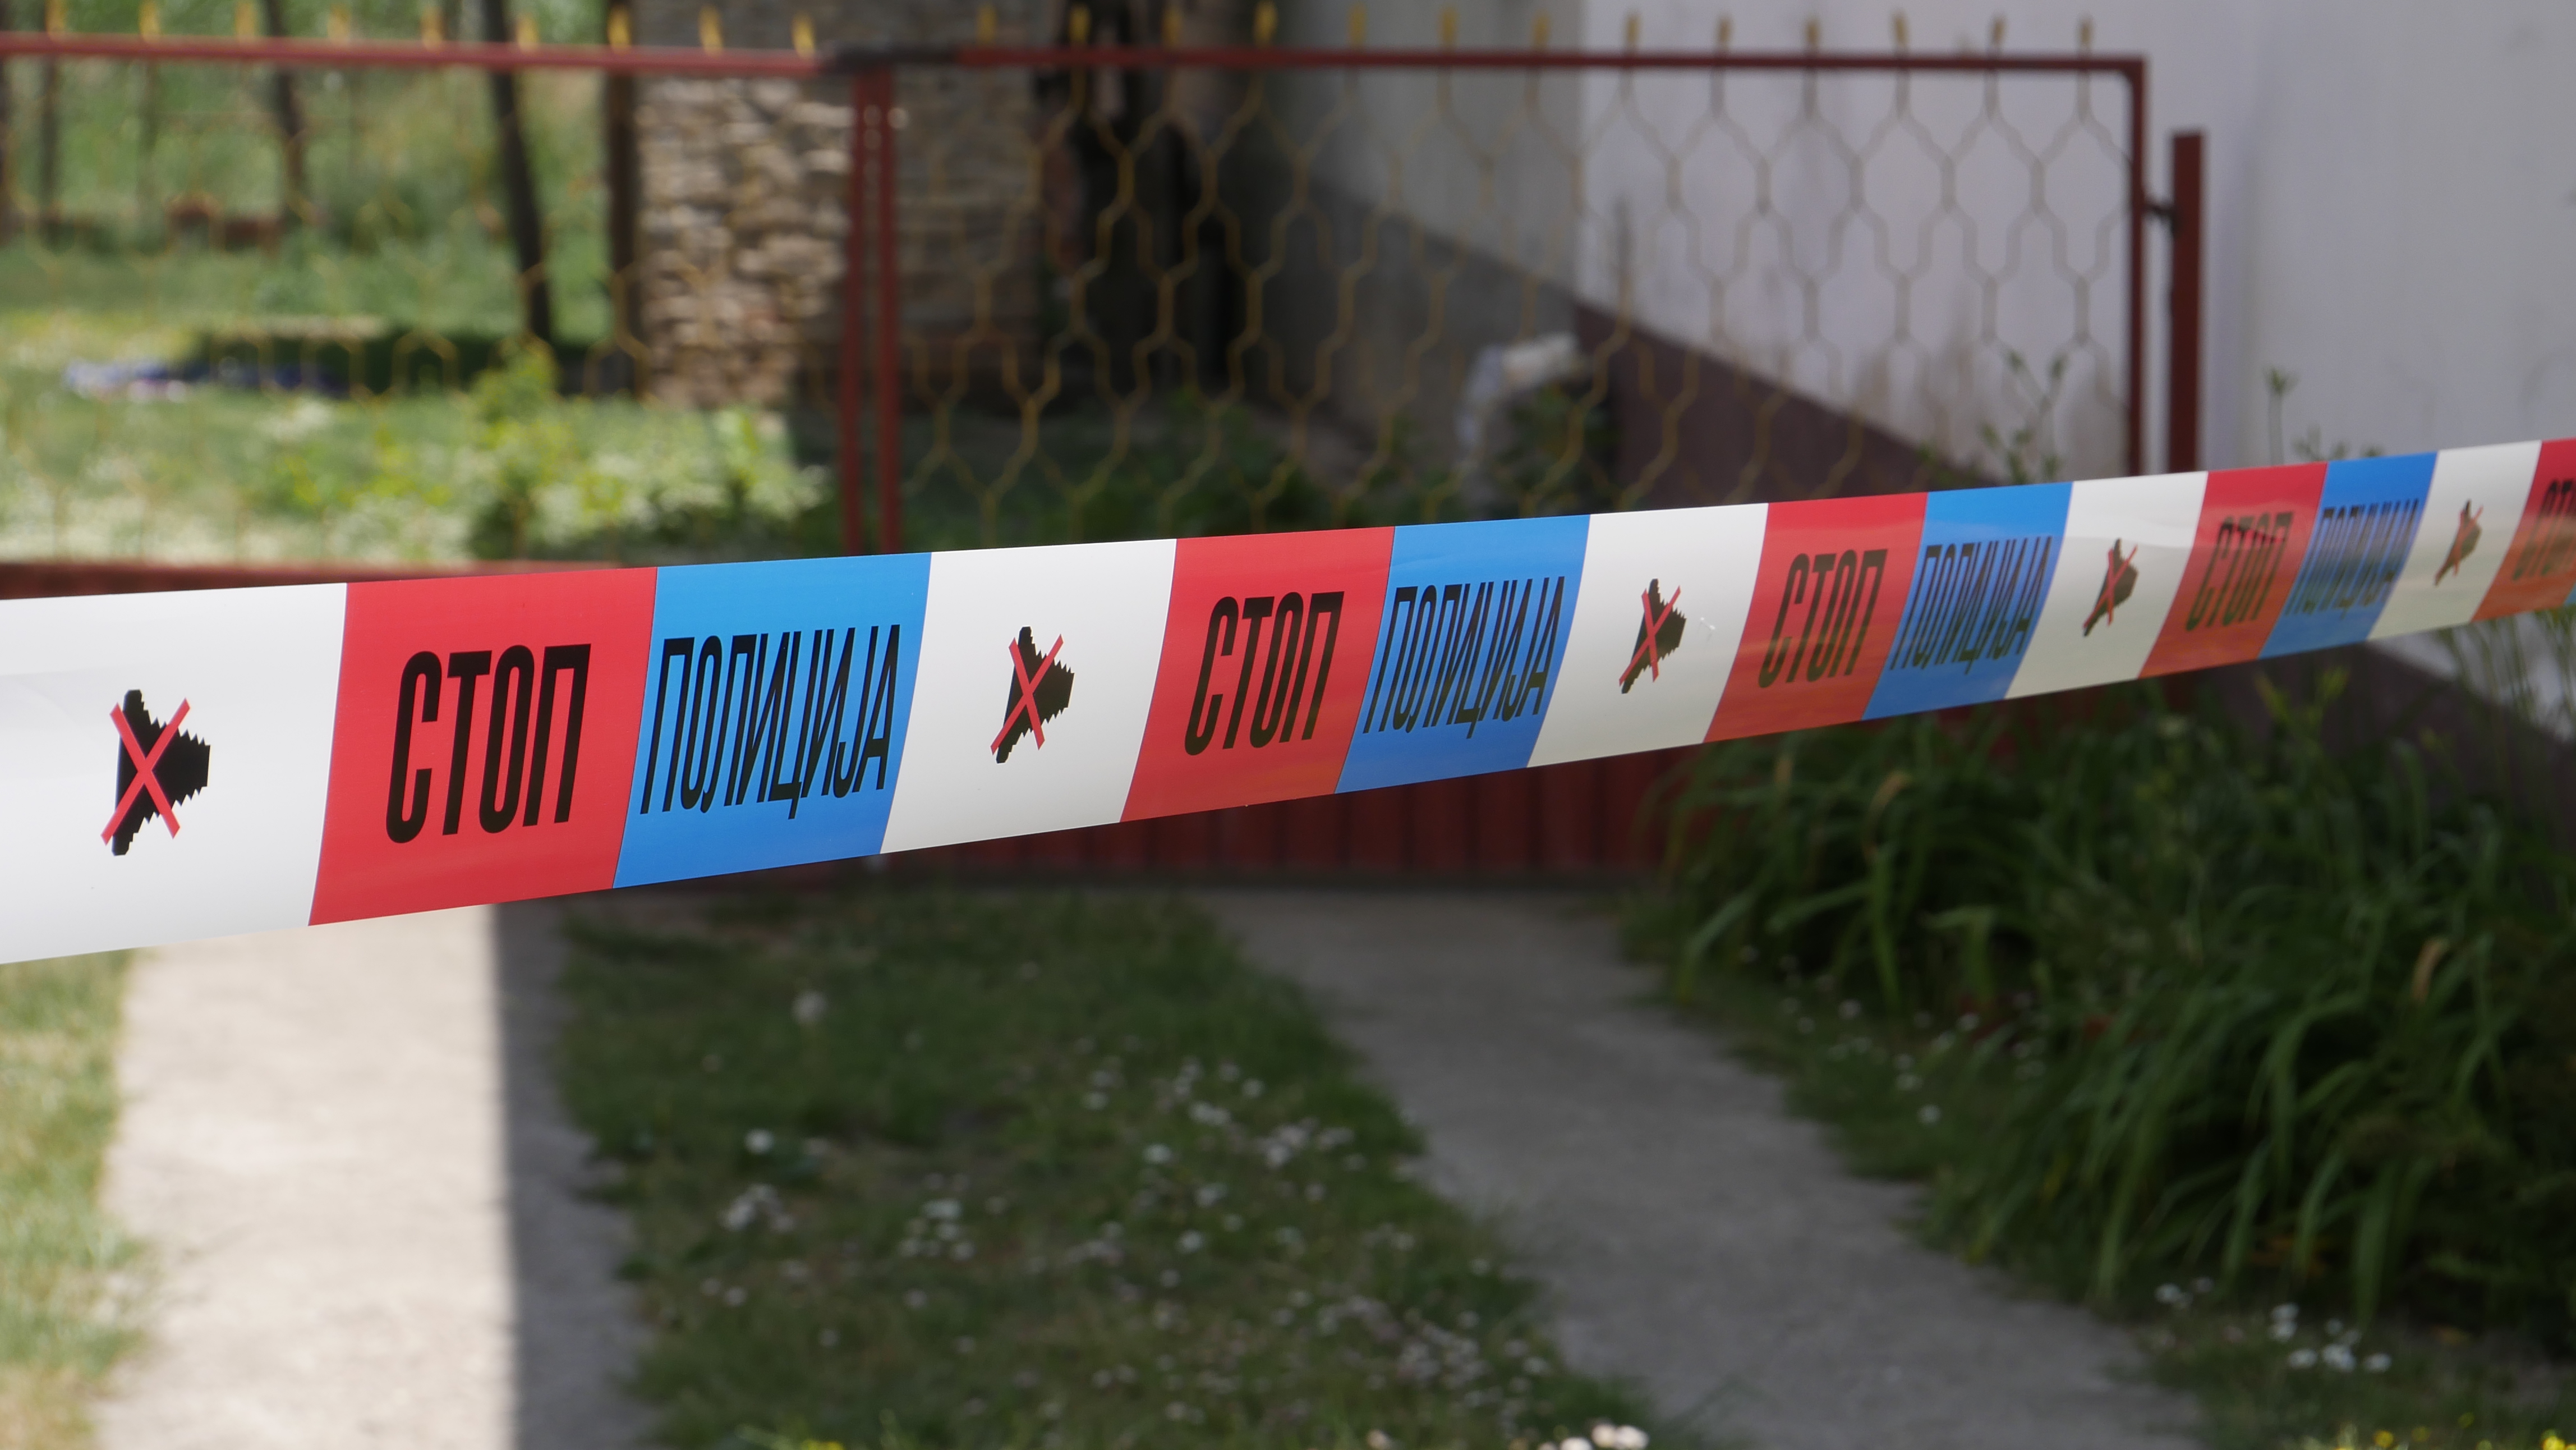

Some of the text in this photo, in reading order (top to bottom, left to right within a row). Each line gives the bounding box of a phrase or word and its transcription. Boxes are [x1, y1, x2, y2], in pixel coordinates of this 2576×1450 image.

[386, 644, 591, 844] СТОП
[640, 624, 900, 820] ПОЛИЦИЈА
[1184, 591, 1345, 756] СТОП
[1362, 576, 1565, 739] ПОЛИЦИЈА
[1758, 549, 1888, 688] СТОП
[1889, 536, 2053, 674] ПОЛИЦИЈА
[2186, 512, 2294, 632] СТОП
